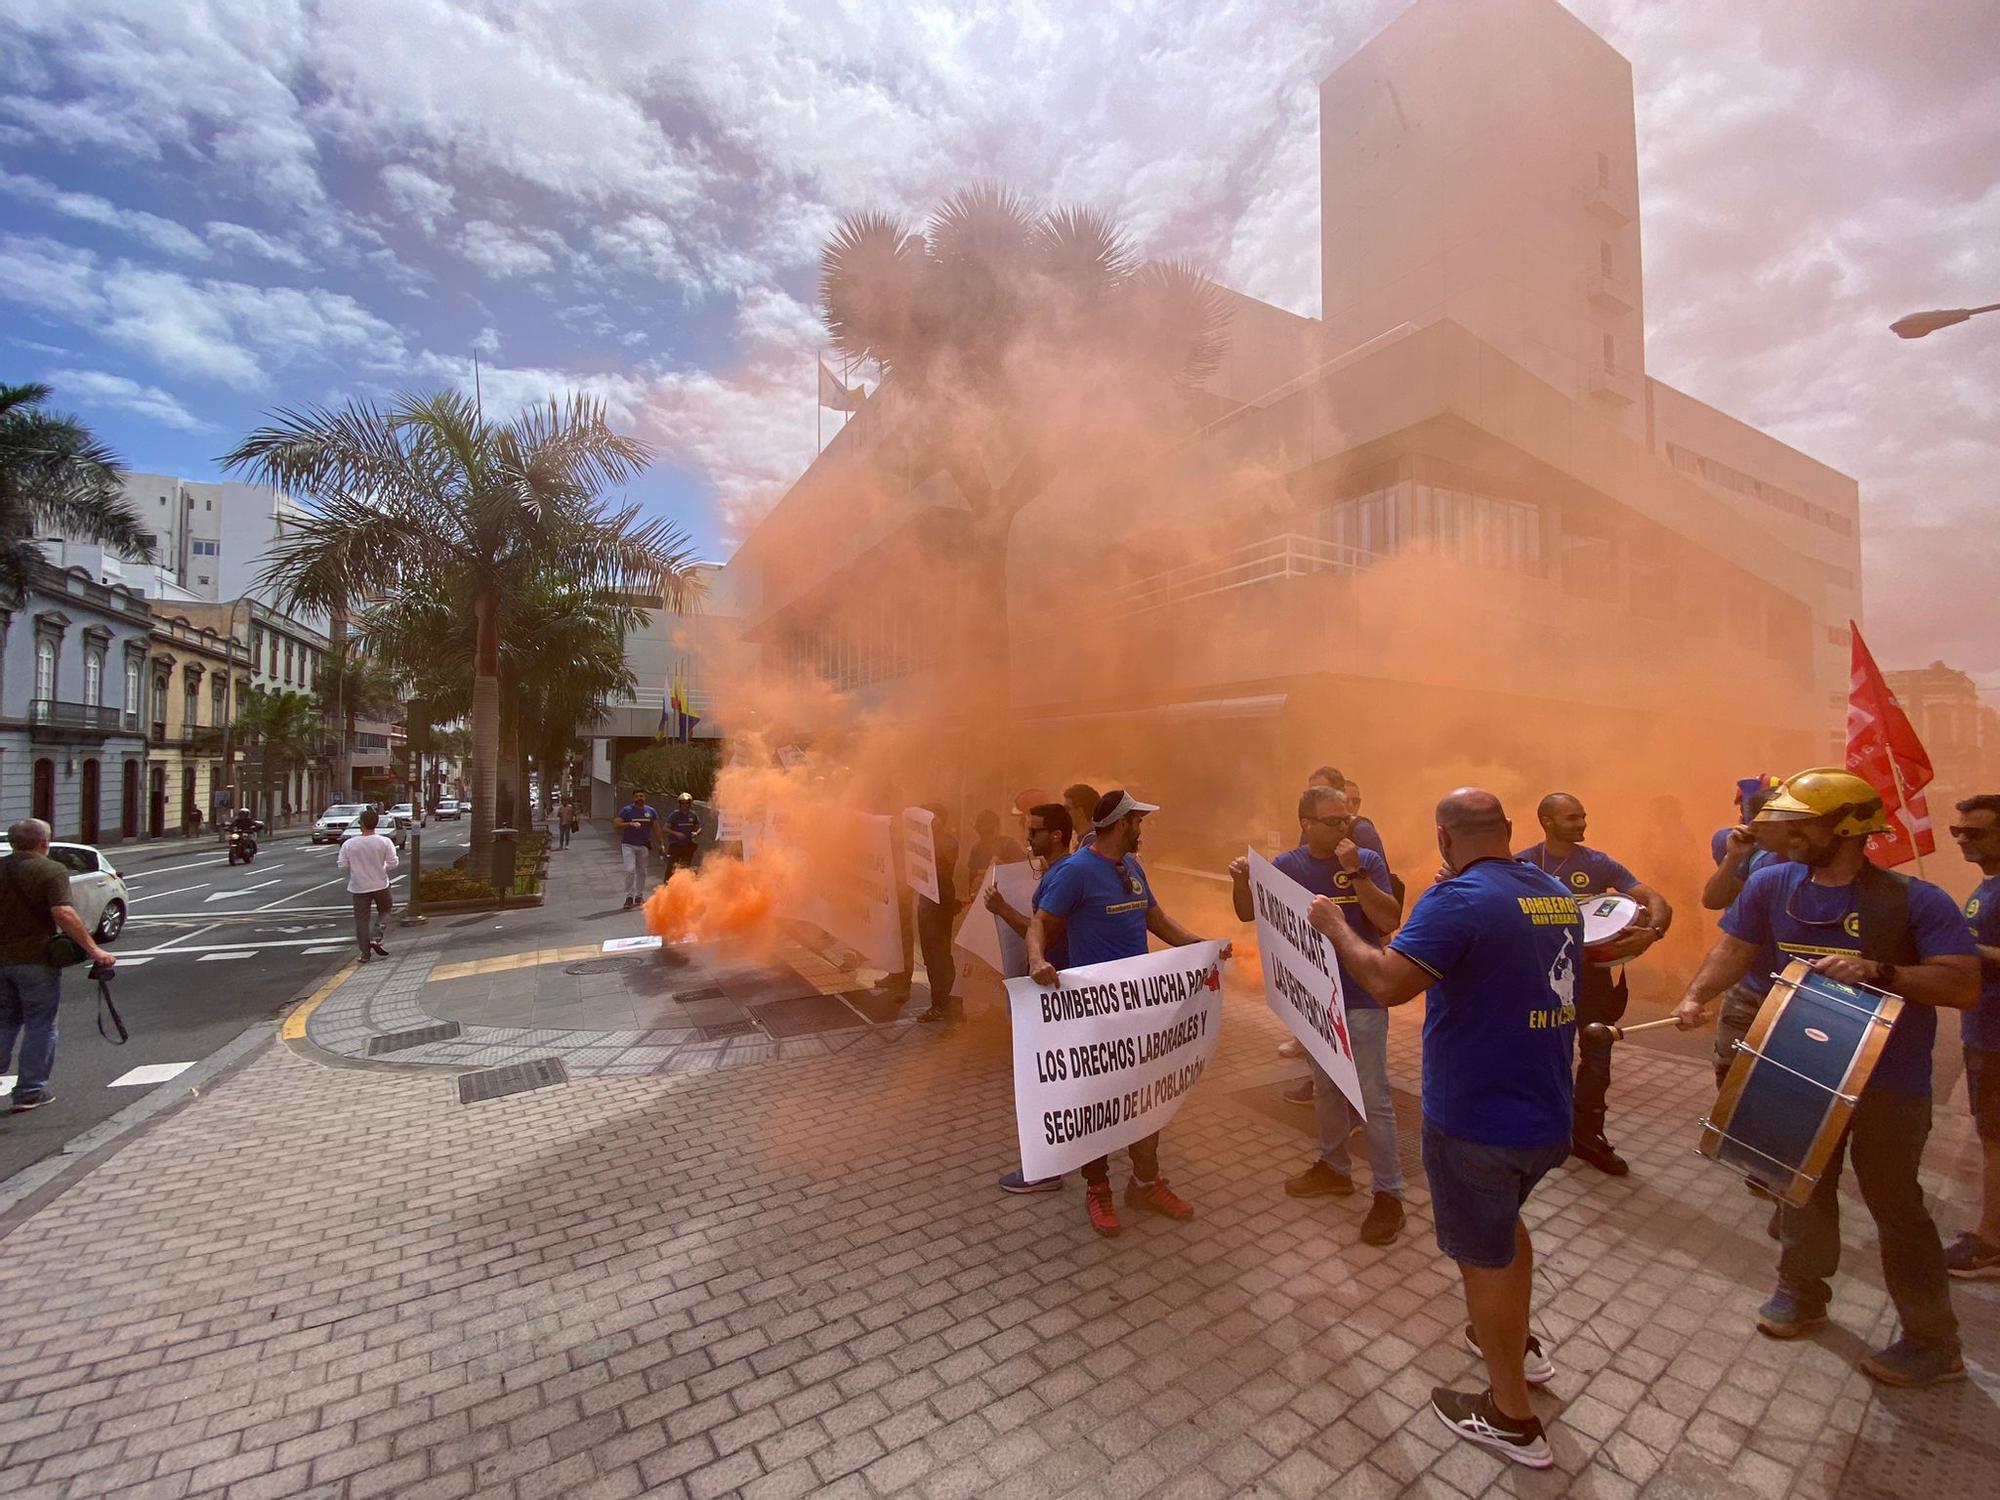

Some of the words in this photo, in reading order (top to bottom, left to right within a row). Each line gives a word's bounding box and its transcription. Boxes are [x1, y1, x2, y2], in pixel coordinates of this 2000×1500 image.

[1298, 915, 1330, 979] ACATE
[1039, 981, 1120, 1024] BOMBEROS
[1120, 979, 1142, 1012] EN
[1143, 972, 1187, 1007] LUCHA
[1271, 951, 1288, 999] LAS
[1284, 966, 1338, 1055] SENTENCIAS
[1529, 1009, 1548, 1029] EN
[1036, 1048, 1067, 1084] LOS
[1069, 1036, 1136, 1080] DRECHOS
[1137, 1013, 1199, 1065] LABORABLES
[1200, 1009, 1208, 1037] Y
[1043, 1096, 1120, 1146] SEGURIDAD
[1123, 1090, 1138, 1124] DE
[1137, 1086, 1153, 1115] LA
